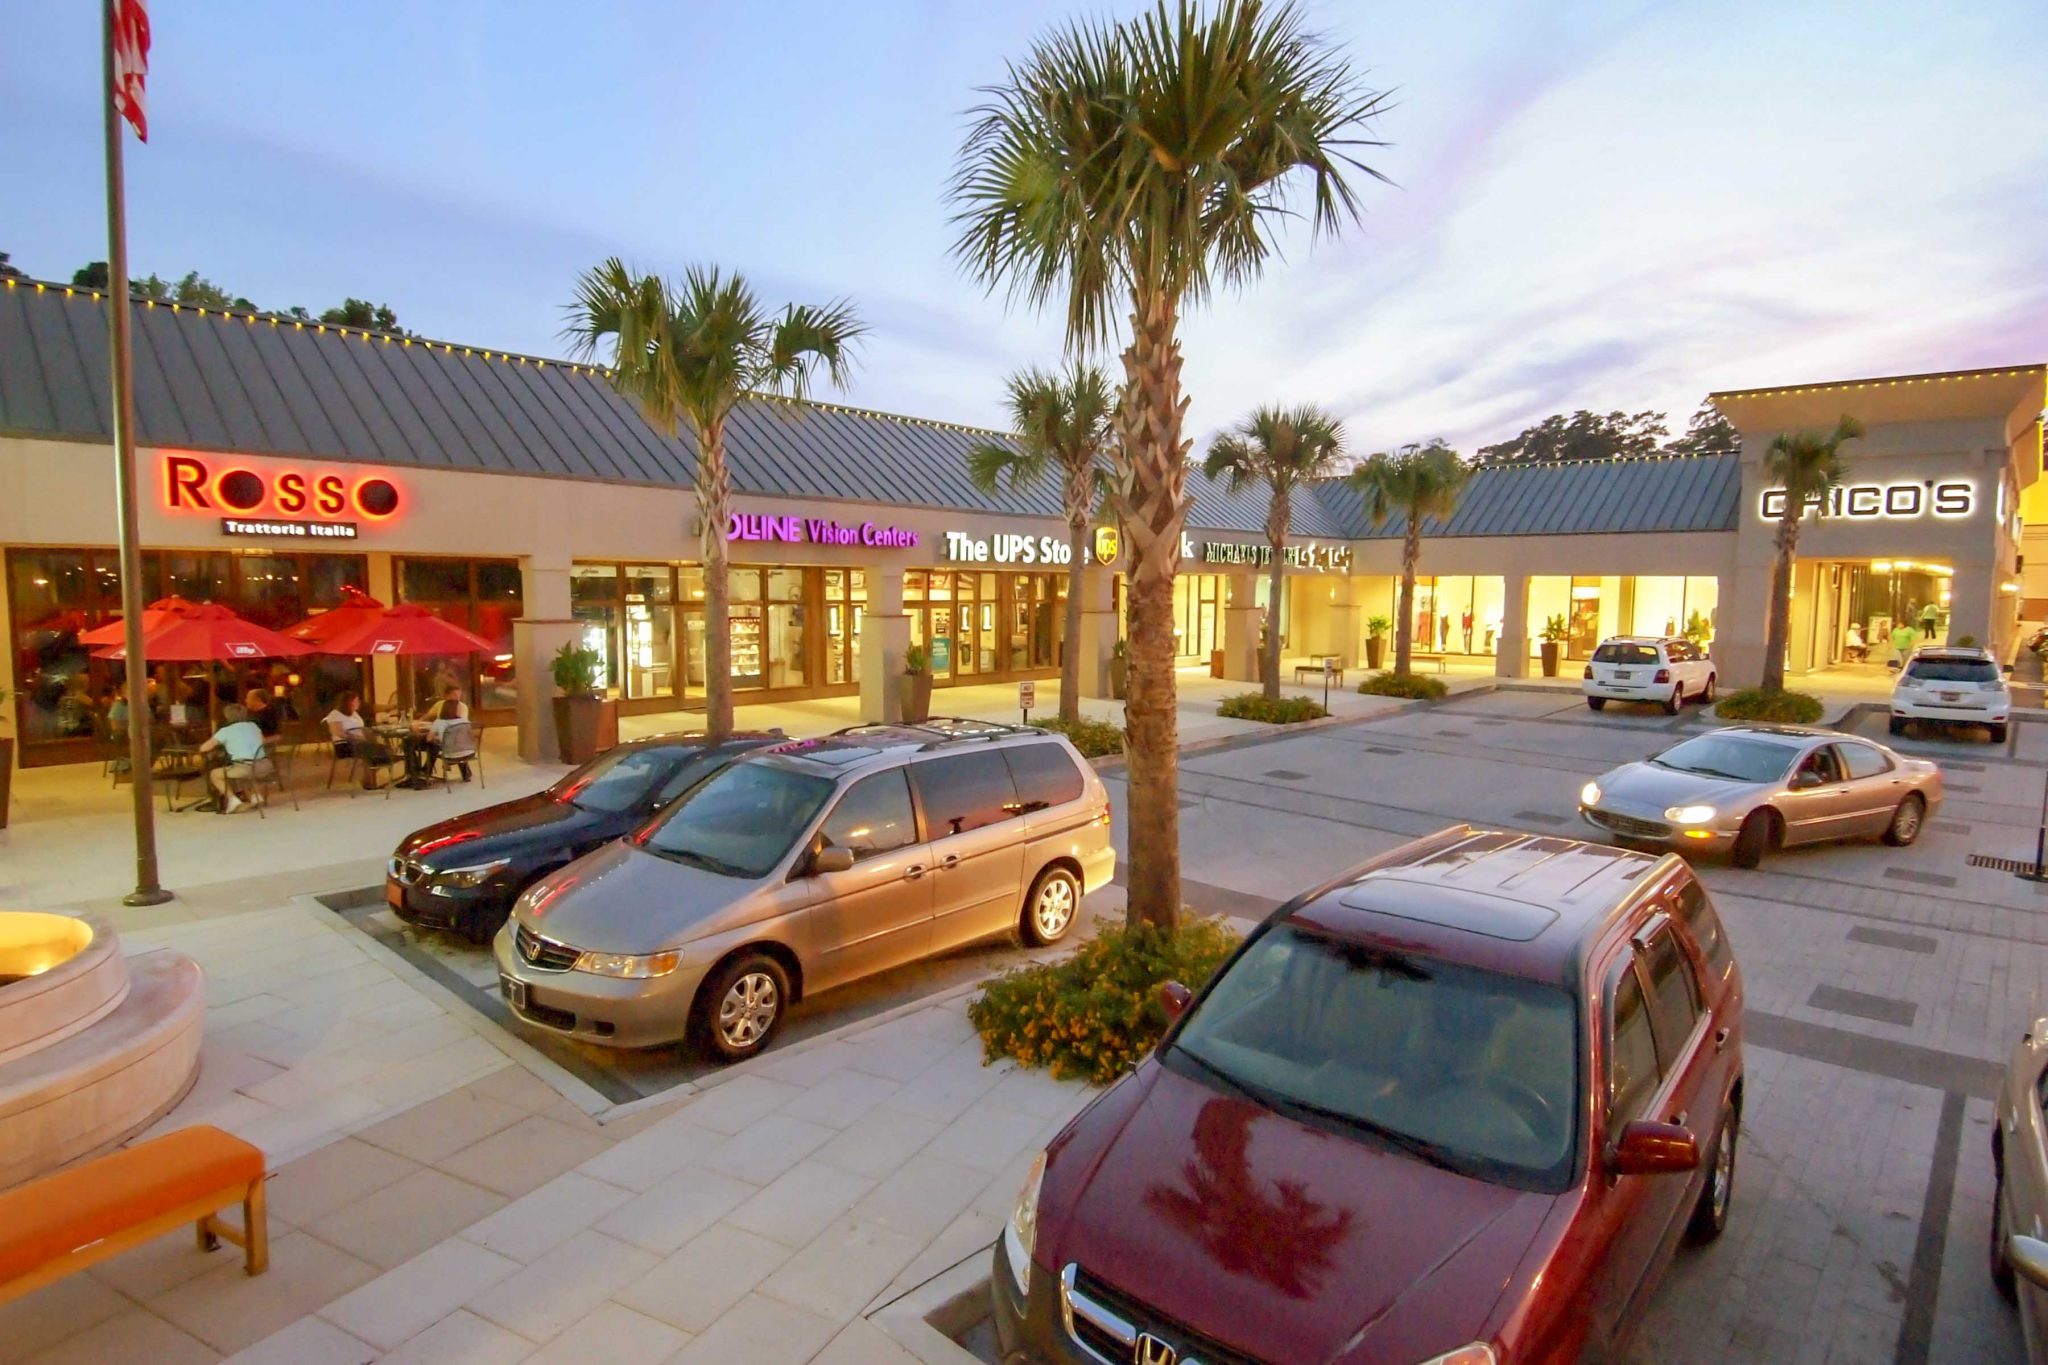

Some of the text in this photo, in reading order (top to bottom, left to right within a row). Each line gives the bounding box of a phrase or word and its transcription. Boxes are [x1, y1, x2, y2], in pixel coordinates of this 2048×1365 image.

[167, 456, 399, 516] ROSSO
[1762, 480, 1972, 518] CHICO'S
[225, 521, 355, 537] Trattoria Italia
[806, 519, 859, 545] Vision
[862, 521, 919, 547] Centers
[946, 532, 1089, 565] The UPS Sto
